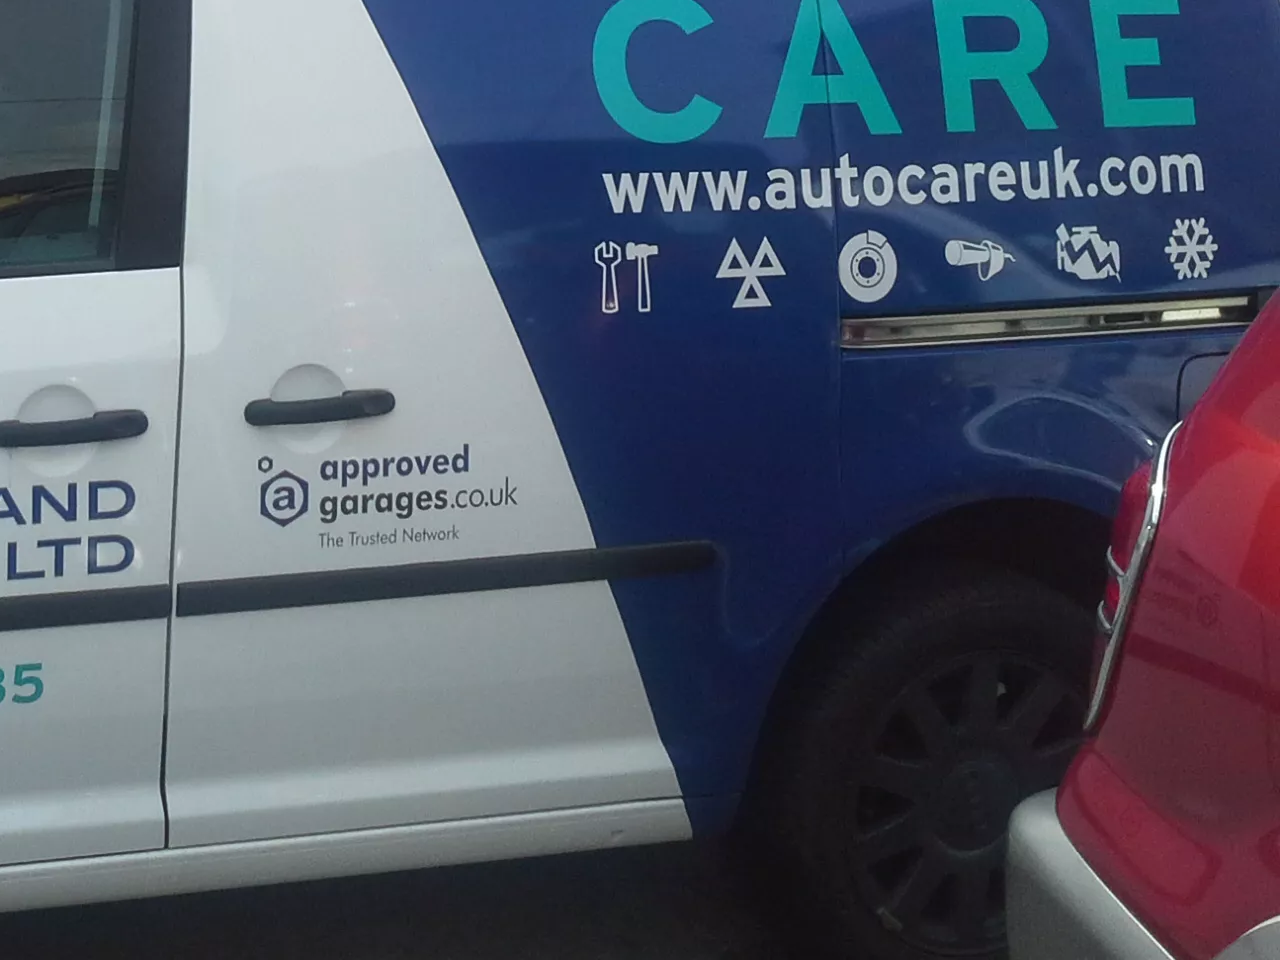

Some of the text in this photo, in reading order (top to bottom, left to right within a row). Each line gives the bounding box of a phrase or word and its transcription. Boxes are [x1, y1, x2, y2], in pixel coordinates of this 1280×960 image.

[602, 146, 1205, 215] www.autocareuk.com
[320, 443, 470, 487] approved
[320, 476, 518, 523] garages.co.uk
[7, 535, 134, 580] LTD
[319, 525, 459, 548] The Trusted Network
